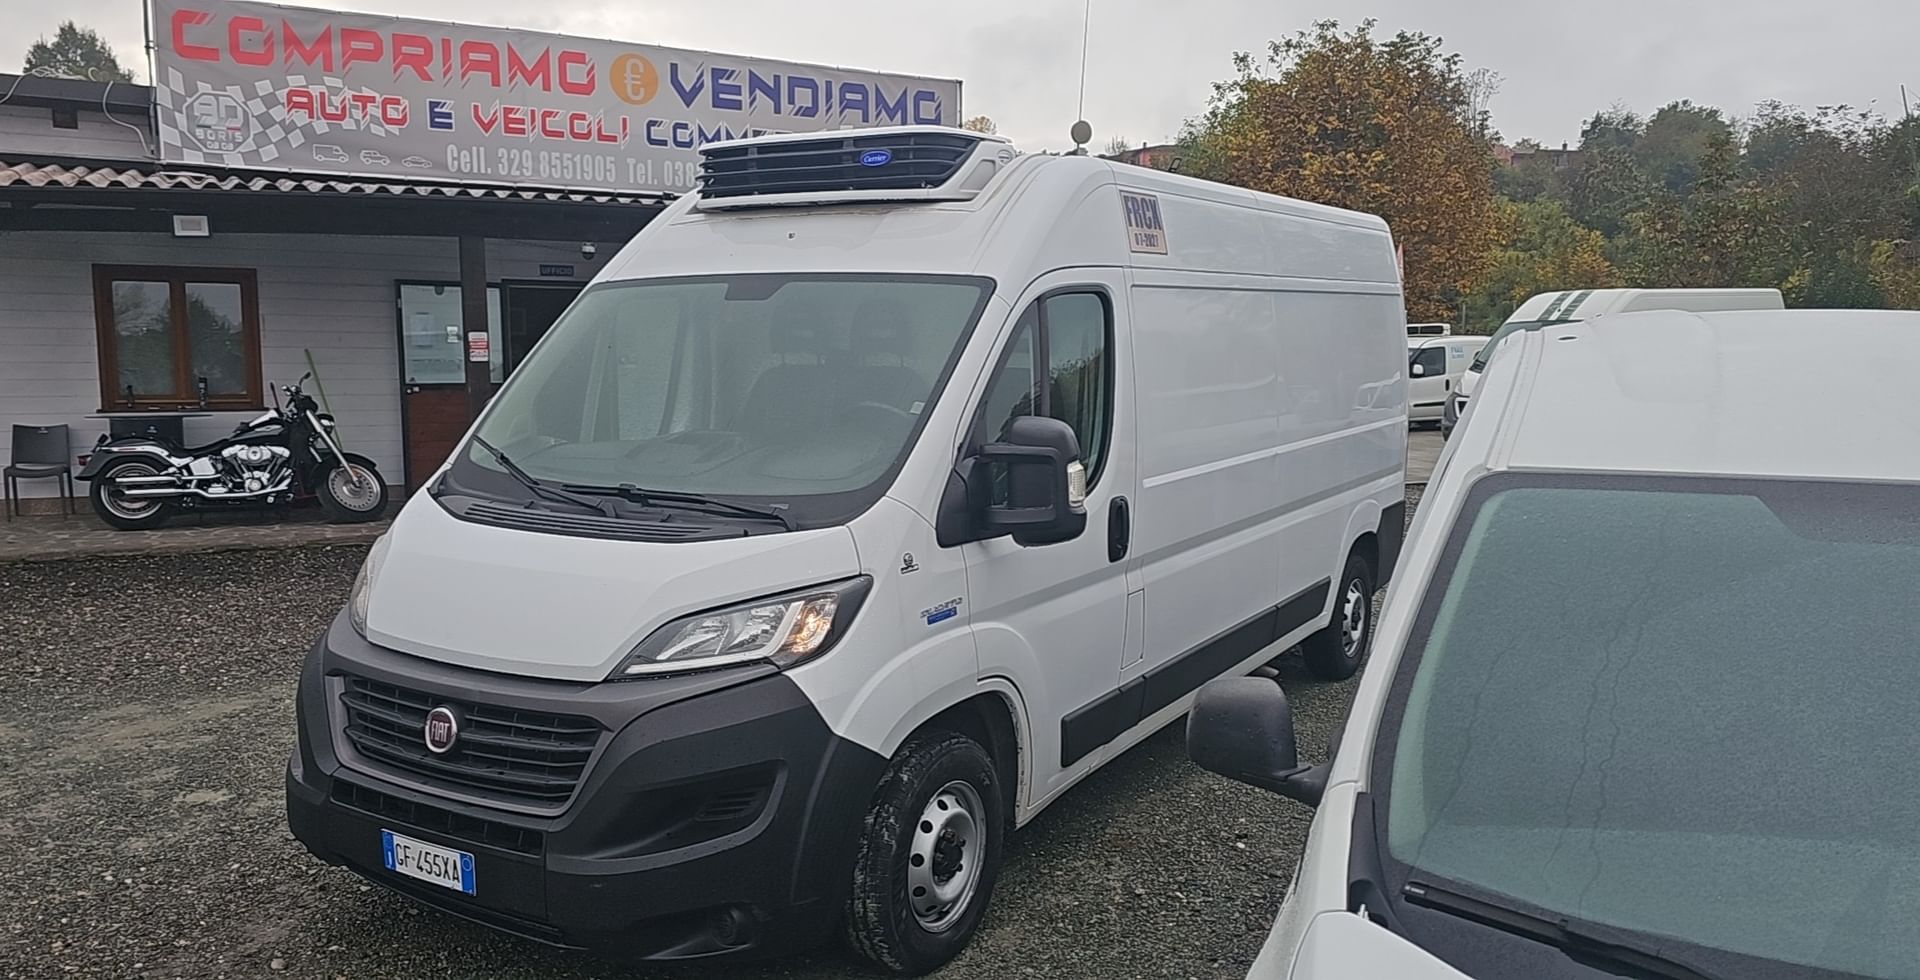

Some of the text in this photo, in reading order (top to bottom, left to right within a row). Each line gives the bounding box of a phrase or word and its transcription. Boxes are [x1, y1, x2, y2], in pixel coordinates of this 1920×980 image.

[171, 9, 596, 96] COMPRIAMO
[670, 61, 942, 125] VENDIAMO
[285, 86, 409, 131] AUTO
[427, 99, 455, 131] E
[471, 101, 630, 147] VEICOLI
[446, 144, 492, 174] Cell.
[498, 147, 533, 176] 329
[540, 151, 616, 182] 8551905
[626, 157, 658, 185] Tel.
[1123, 195, 1162, 231] FRCX
[431, 720, 450, 742] FIAT
